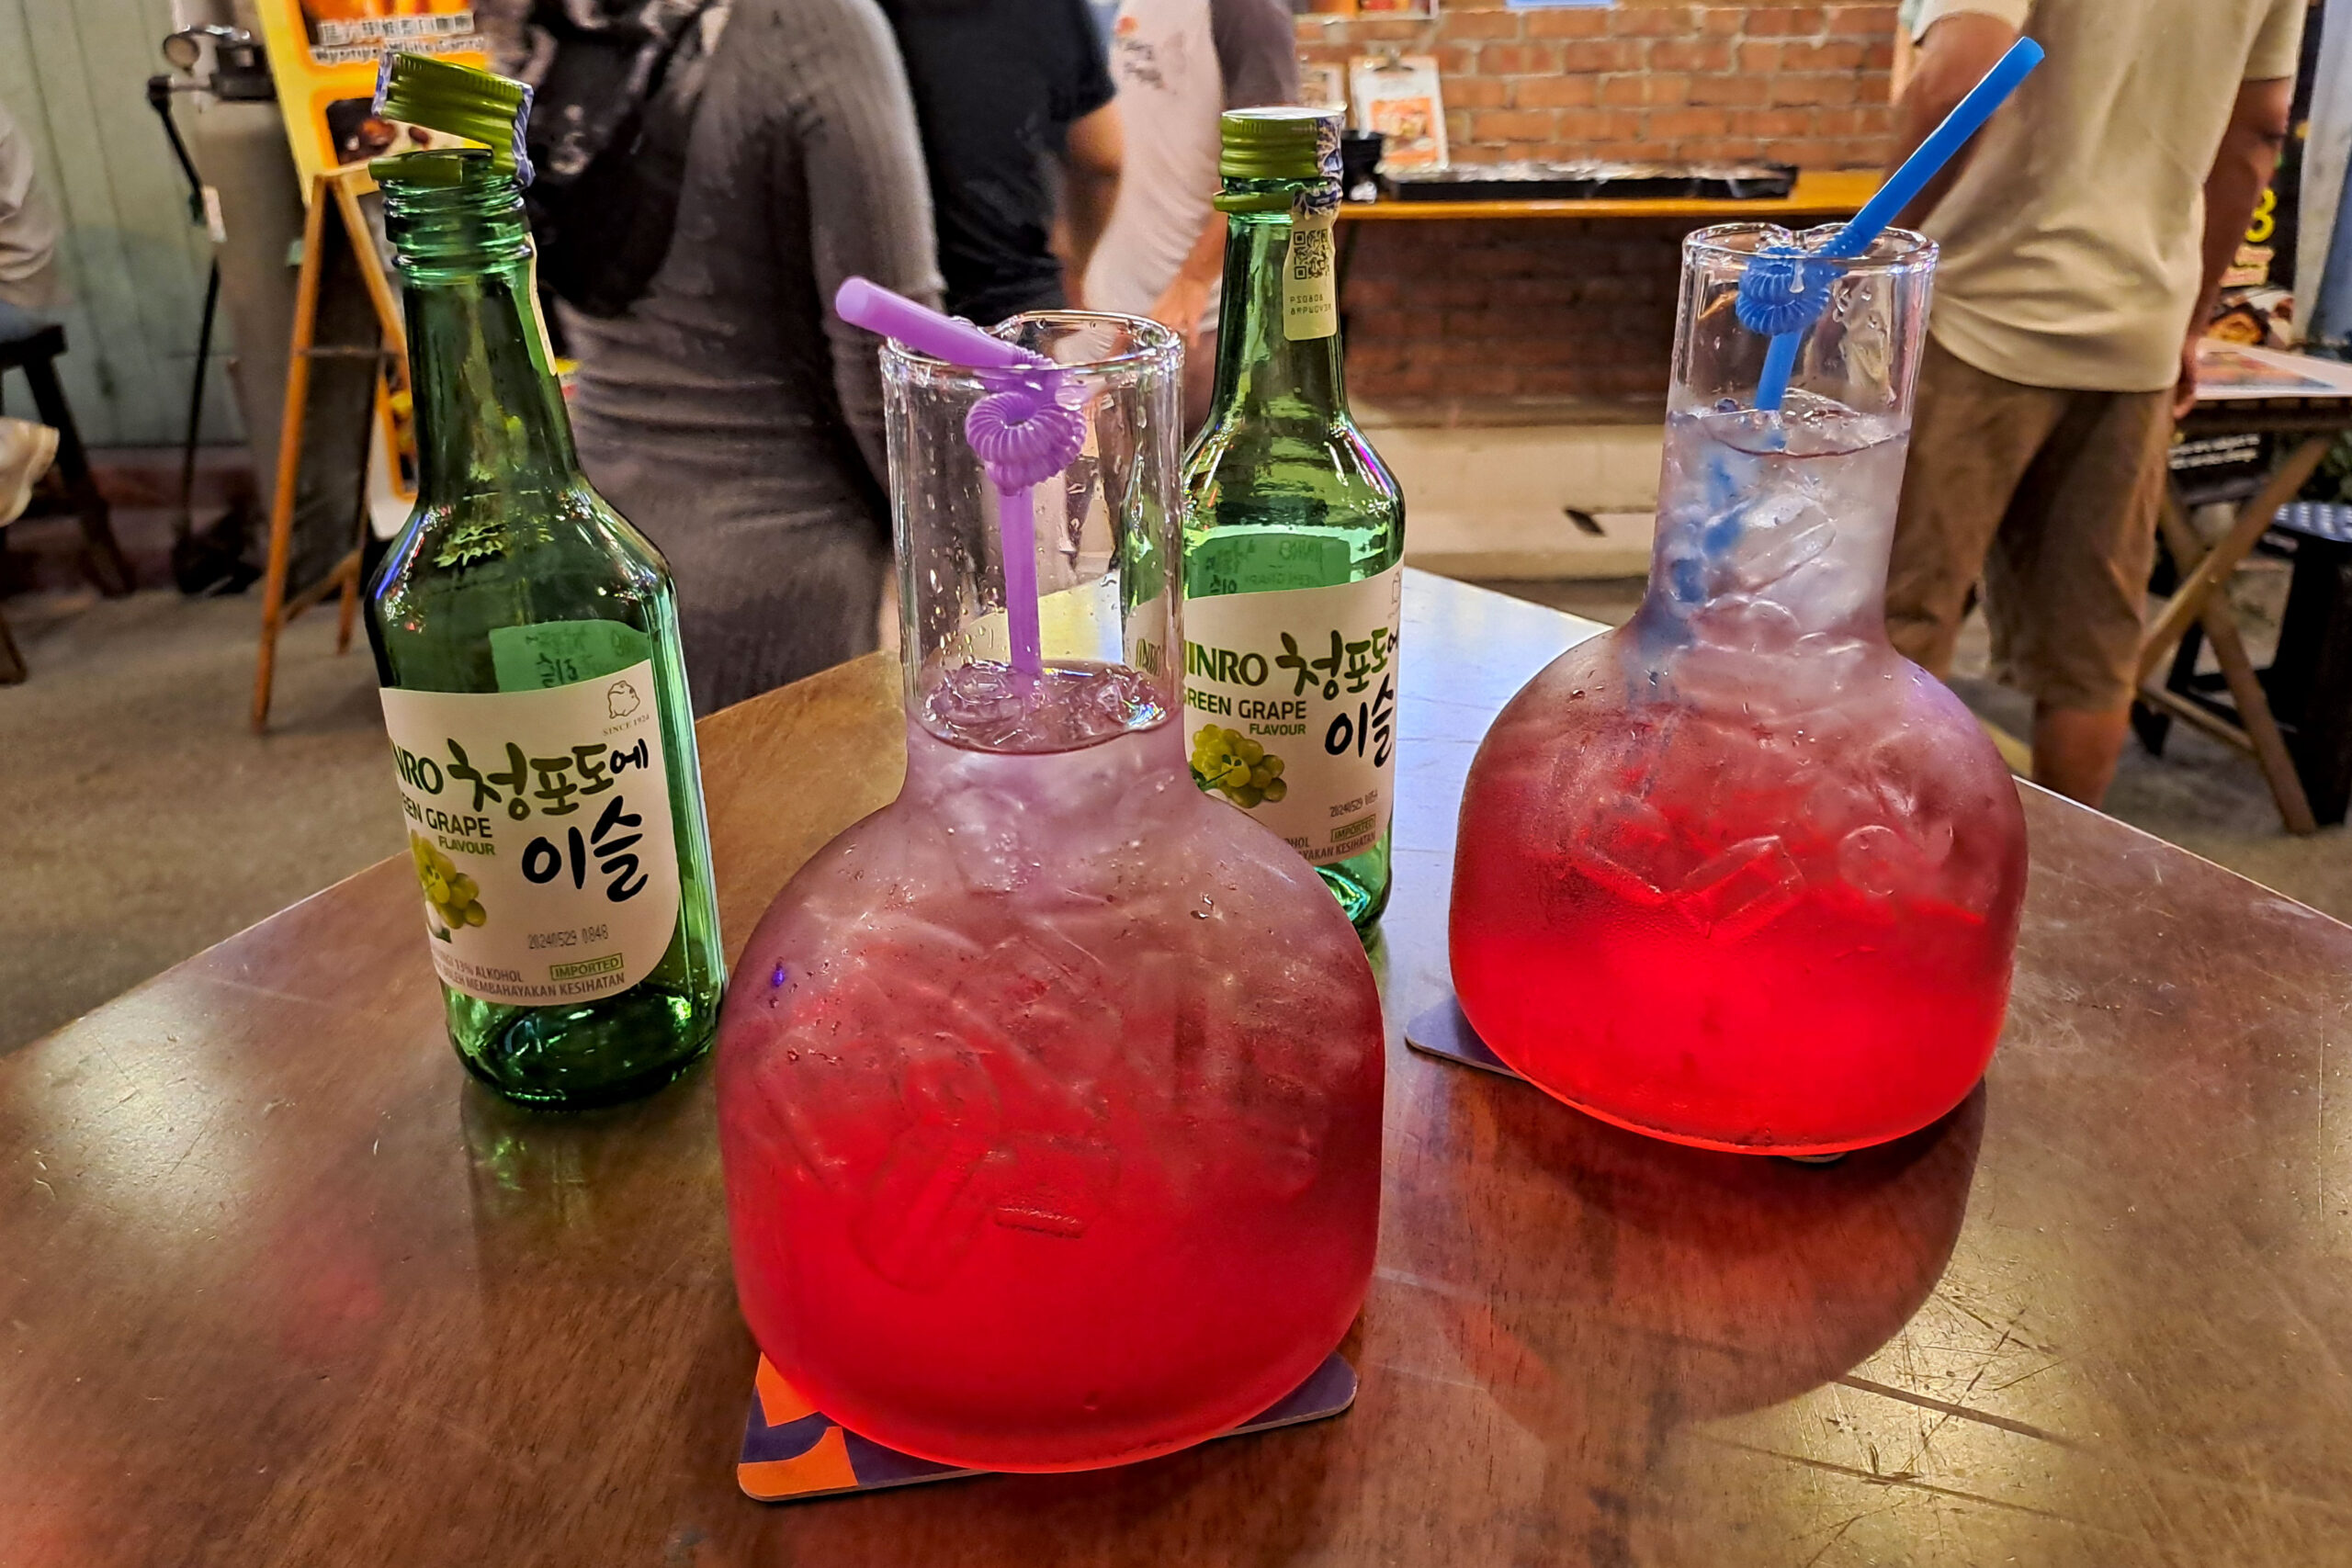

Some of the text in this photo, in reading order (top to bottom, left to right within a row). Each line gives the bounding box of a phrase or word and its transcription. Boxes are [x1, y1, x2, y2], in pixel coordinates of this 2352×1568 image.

[1238, 699, 1307, 720] GRAPE
[1324, 673, 1395, 769] 이슬
[602, 721, 632, 736] SINCE
[1250, 722, 1306, 736] FLAVOUR
[391, 739, 445, 795] NRO
[401, 791, 493, 839] EEN GRAPE
[1334, 816, 1375, 840] IMPORTED
[437, 834, 497, 856] FLAVOUR
[521, 795, 649, 903] 이슬
[1336, 830, 1376, 855] KESIHATAN
[475, 964, 524, 984] ALKOHOL
[554, 957, 620, 978] IMPORTED
[466, 977, 557, 998] MEMBAHAYAKAN
[559, 973, 626, 997] KESIHATAN
